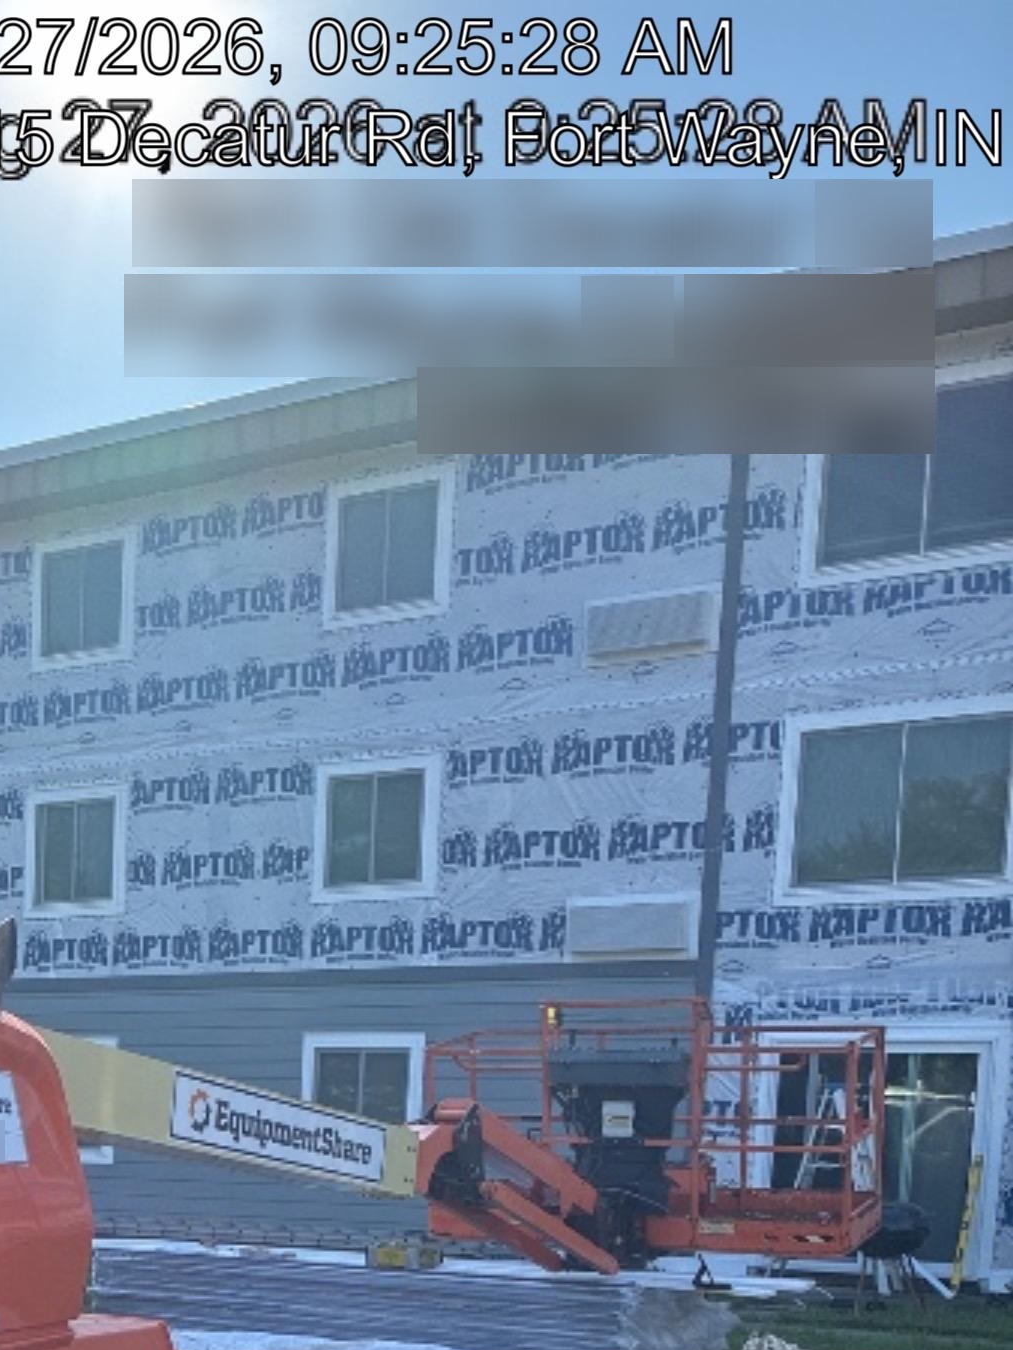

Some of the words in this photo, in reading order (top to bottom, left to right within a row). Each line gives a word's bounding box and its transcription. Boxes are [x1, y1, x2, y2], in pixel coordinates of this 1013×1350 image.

[241, 490, 324, 537] RAPTO
[521, 512, 645, 574] RAPTOR
[341, 634, 450, 688] RAPTOR
[456, 617, 573, 672] RAPTOR
[738, 586, 855, 629] APTOR
[131, 768, 210, 807] APTOR
[448, 737, 544, 780] APTOR
[551, 721, 675, 775] RAPTOR
[482, 821, 600, 867] RAPTOR
[208, 918, 303, 965] RAPTOR
[311, 915, 413, 957] RAPTOR
[809, 905, 951, 942] RAPTOR
[215, 1099, 373, 1165] EquipmentShare
